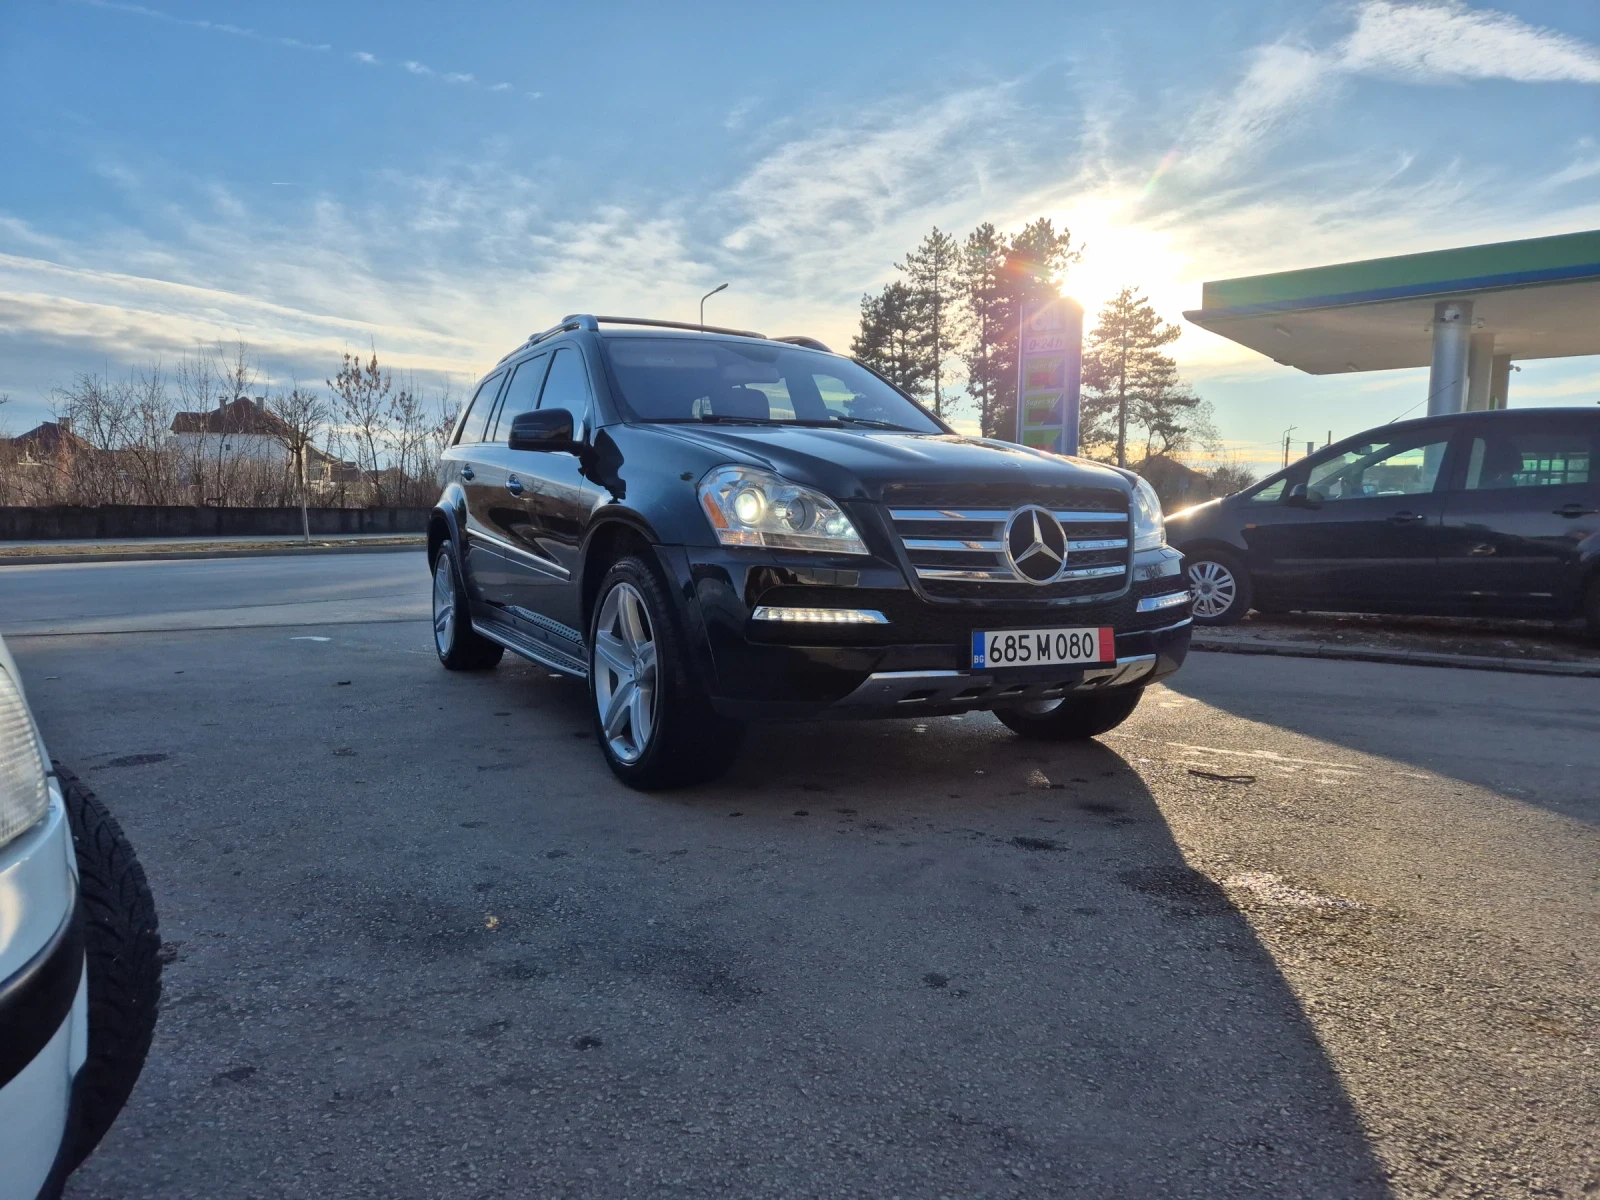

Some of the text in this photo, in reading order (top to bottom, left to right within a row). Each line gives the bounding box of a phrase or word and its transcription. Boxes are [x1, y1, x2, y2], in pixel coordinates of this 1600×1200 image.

[974, 632, 1094, 663] BG 685 M 080
